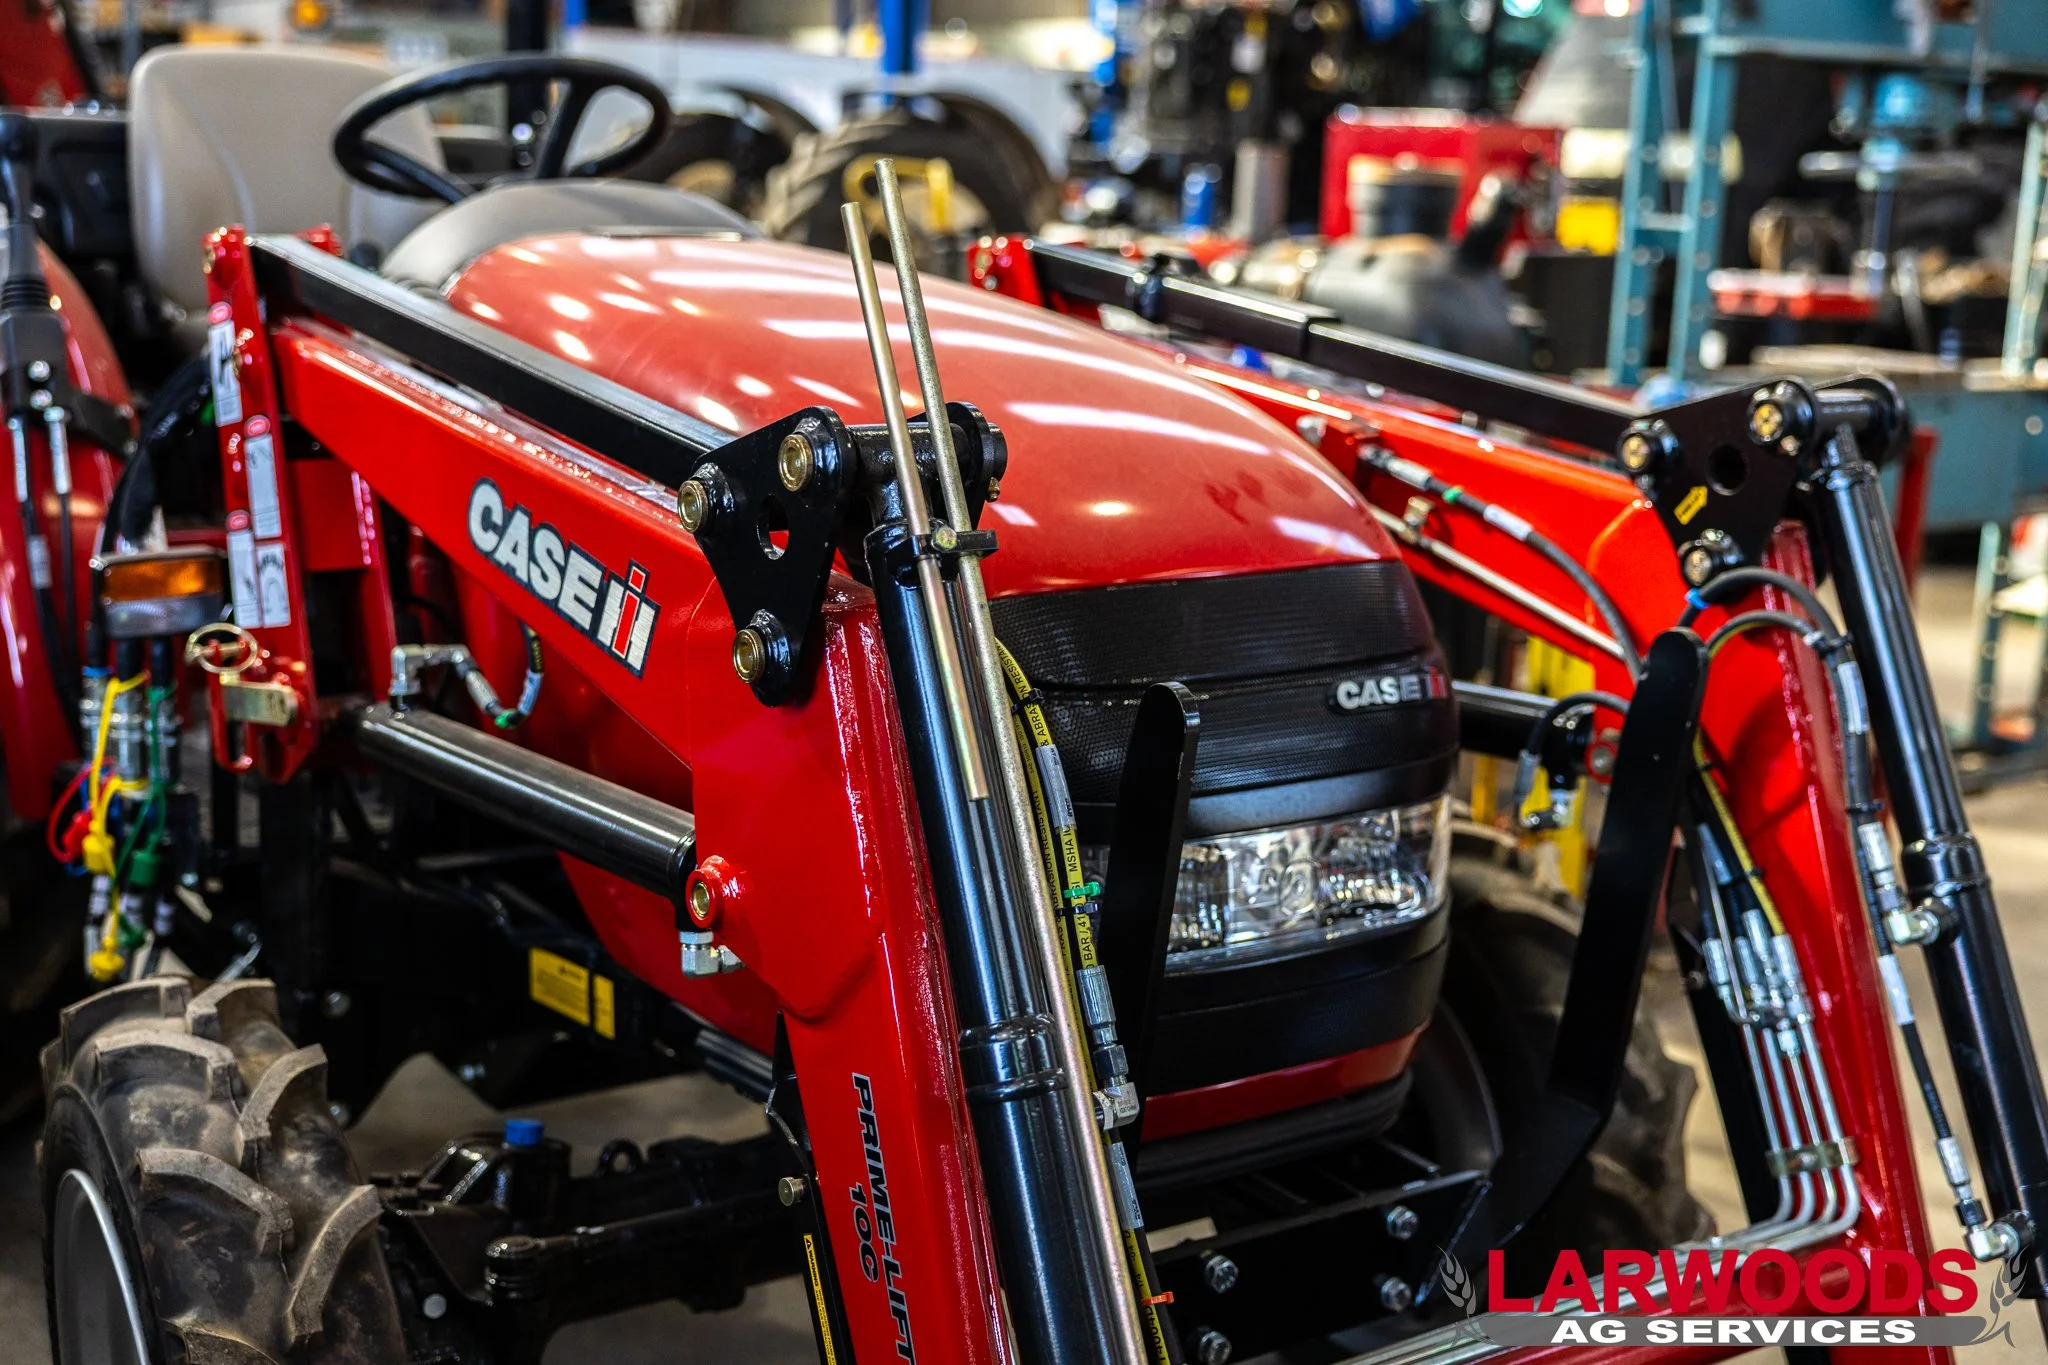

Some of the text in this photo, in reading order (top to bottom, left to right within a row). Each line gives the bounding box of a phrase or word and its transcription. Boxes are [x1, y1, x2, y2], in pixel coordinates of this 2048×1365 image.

[467, 481, 605, 636] CASE
[1020, 686, 1047, 736] ABRASON
[1337, 675, 1421, 710] CASE
[1064, 839, 1077, 872] MSHA
[1081, 937, 1092, 960] BAR
[849, 1182, 880, 1283] 10C
[851, 1072, 917, 1365] PRIME-LIFT
